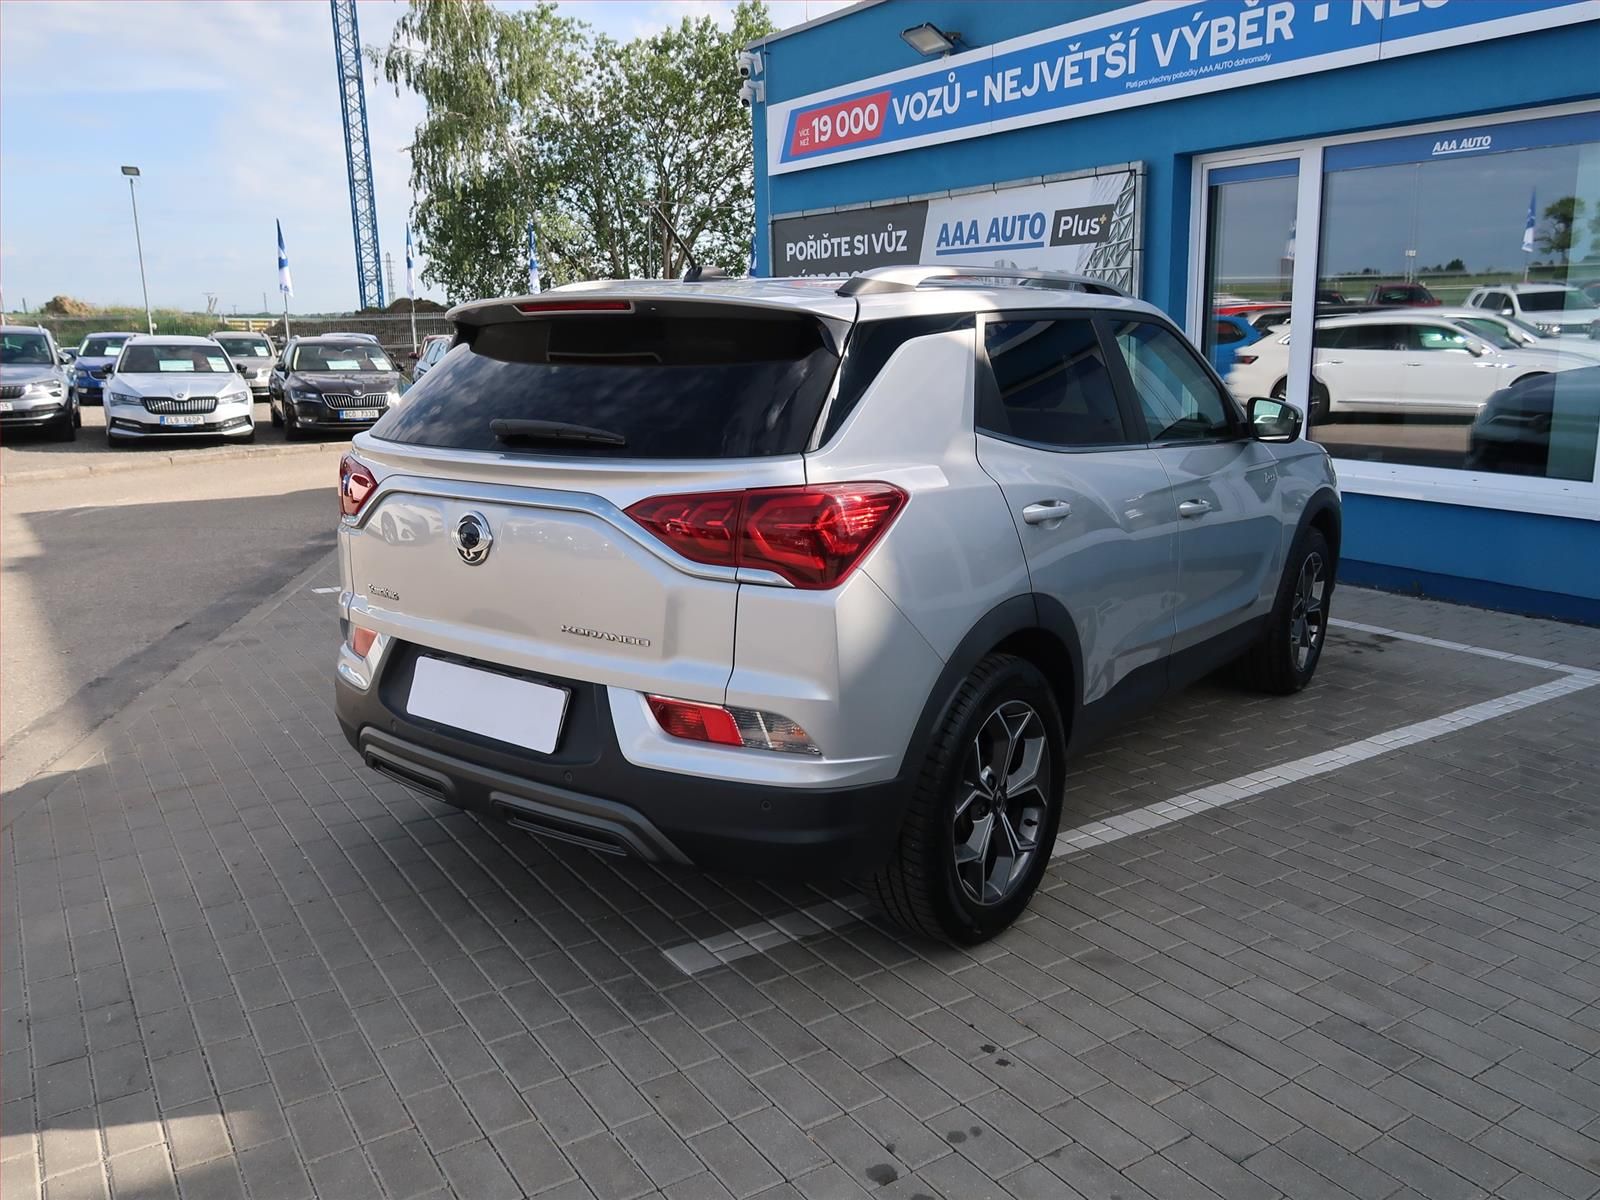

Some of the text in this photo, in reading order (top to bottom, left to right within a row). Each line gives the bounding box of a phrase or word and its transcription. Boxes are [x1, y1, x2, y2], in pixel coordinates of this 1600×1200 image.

[812, 115, 832, 143] 19
[836, 103, 879, 137] 000
[892, 71, 961, 125] VOZŮ
[984, 27, 1141, 107] NEJVĚTŠÍ
[1151, 0, 1295, 68] VÝBĚR
[1138, 79, 1148, 88] pro
[1148, 74, 1172, 84] všechny
[1172, 69, 1198, 81] pobočky
[1199, 65, 1214, 74] AAA
[1214, 60, 1234, 71] AUTO
[1234, 53, 1272, 66] dohromady
[1432, 135, 1492, 153] AAA AUTO
[786, 223, 908, 262] POŘIĎTE SI VŮZ
[936, 219, 979, 248] AAA
[986, 212, 1046, 244] AUTO
